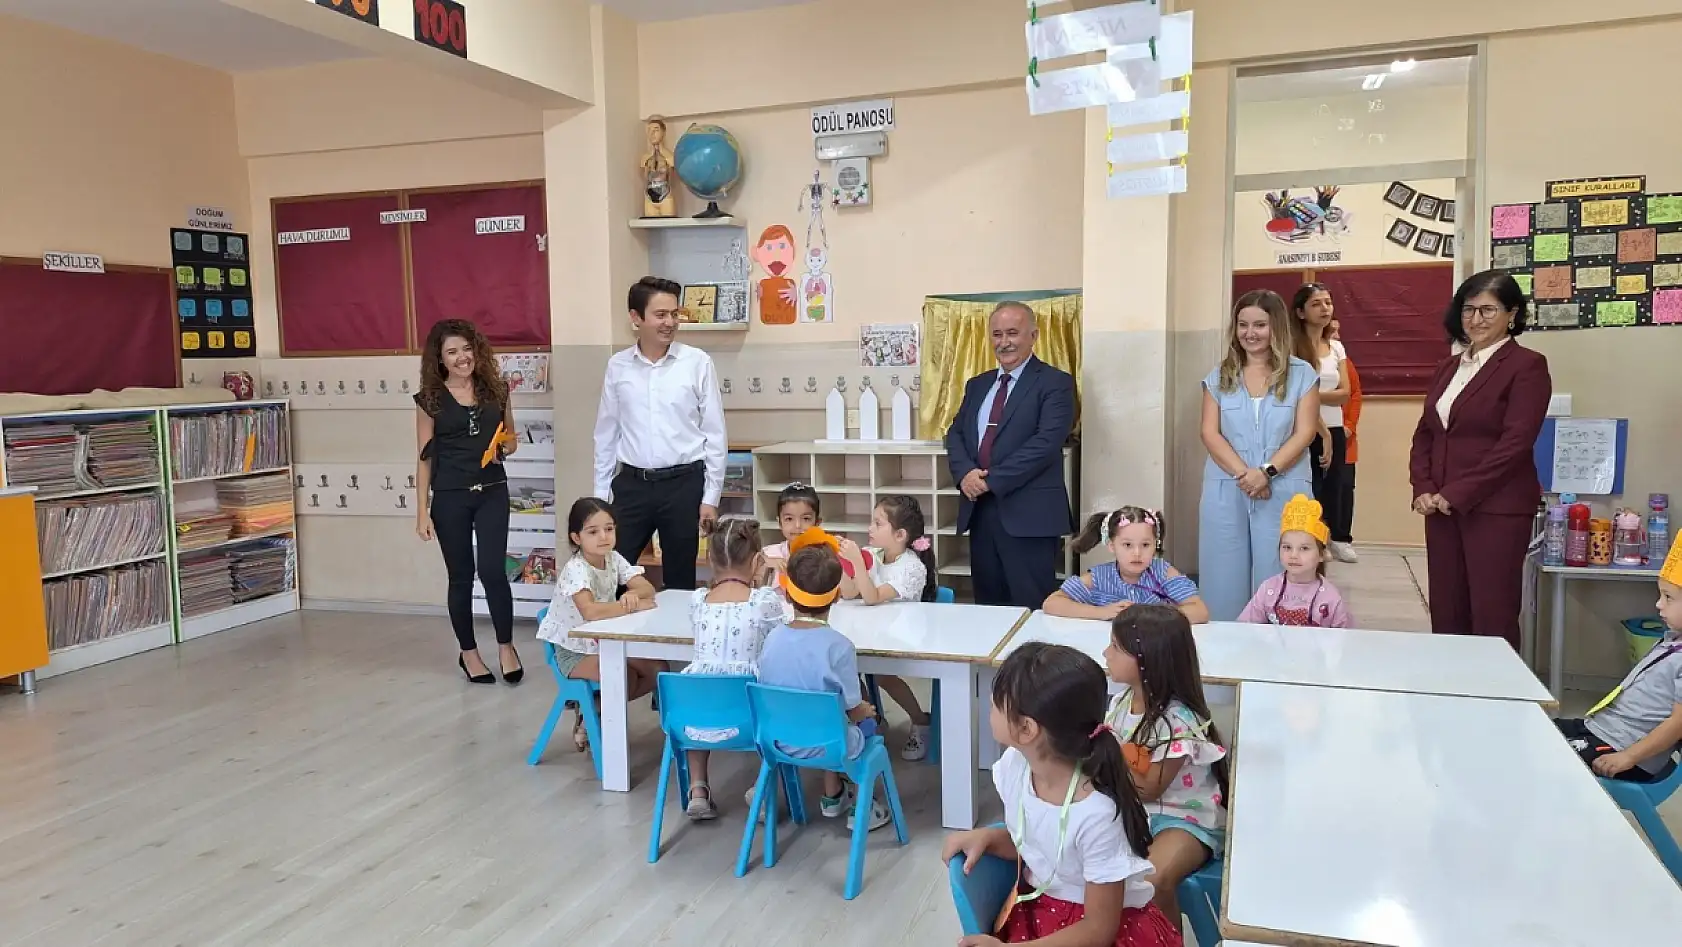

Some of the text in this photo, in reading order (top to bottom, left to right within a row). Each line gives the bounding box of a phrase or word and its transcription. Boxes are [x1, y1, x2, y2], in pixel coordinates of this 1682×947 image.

[415, 0, 464, 50] 100
[812, 107, 893, 133] ÖDÜL PANOSU
[1553, 181, 1636, 194] SINIF KURALLARI
[196, 207, 224, 218] DOĞUM
[477, 218, 521, 233] GÜNLER
[280, 228, 349, 243] HAVA DURUMU
[44, 253, 102, 269] ŞEKİLLER
